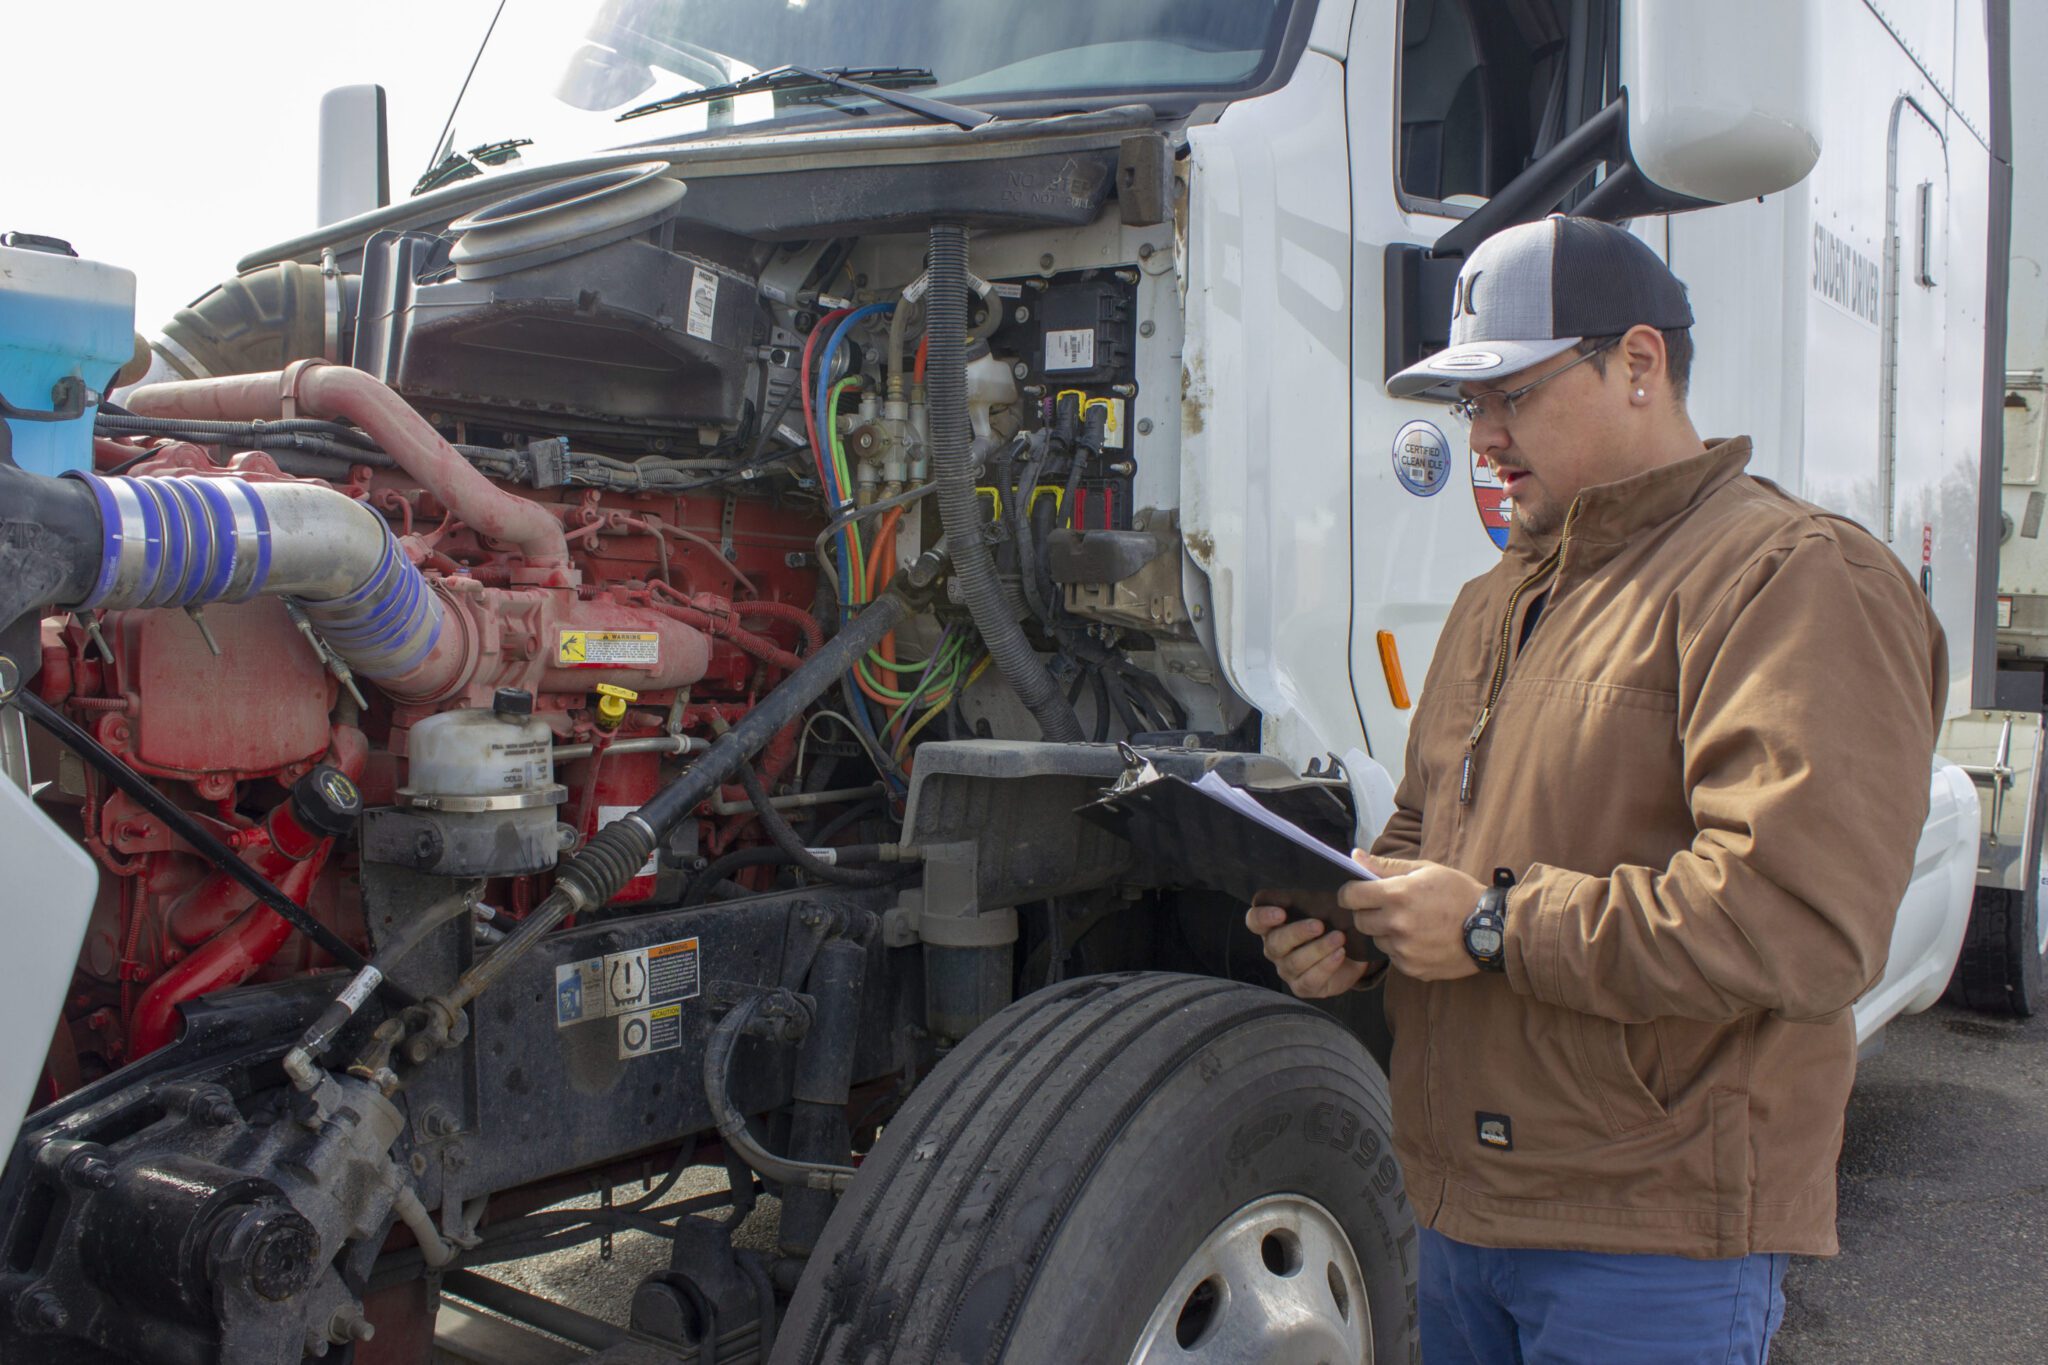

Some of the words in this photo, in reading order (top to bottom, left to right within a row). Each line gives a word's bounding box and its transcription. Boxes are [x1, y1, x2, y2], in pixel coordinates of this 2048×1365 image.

[1032, 192, 1056, 204] NOT
[1812, 220, 1850, 309] STUDENT
[1851, 249, 1879, 327] DRIVER
[1404, 443, 1440, 457] CERTIFIED
[1401, 455, 1425, 467] CLEAN
[1427, 459, 1443, 470] IDLE
[503, 775, 523, 783] COLD
[656, 1007, 680, 1017] CAUTION
